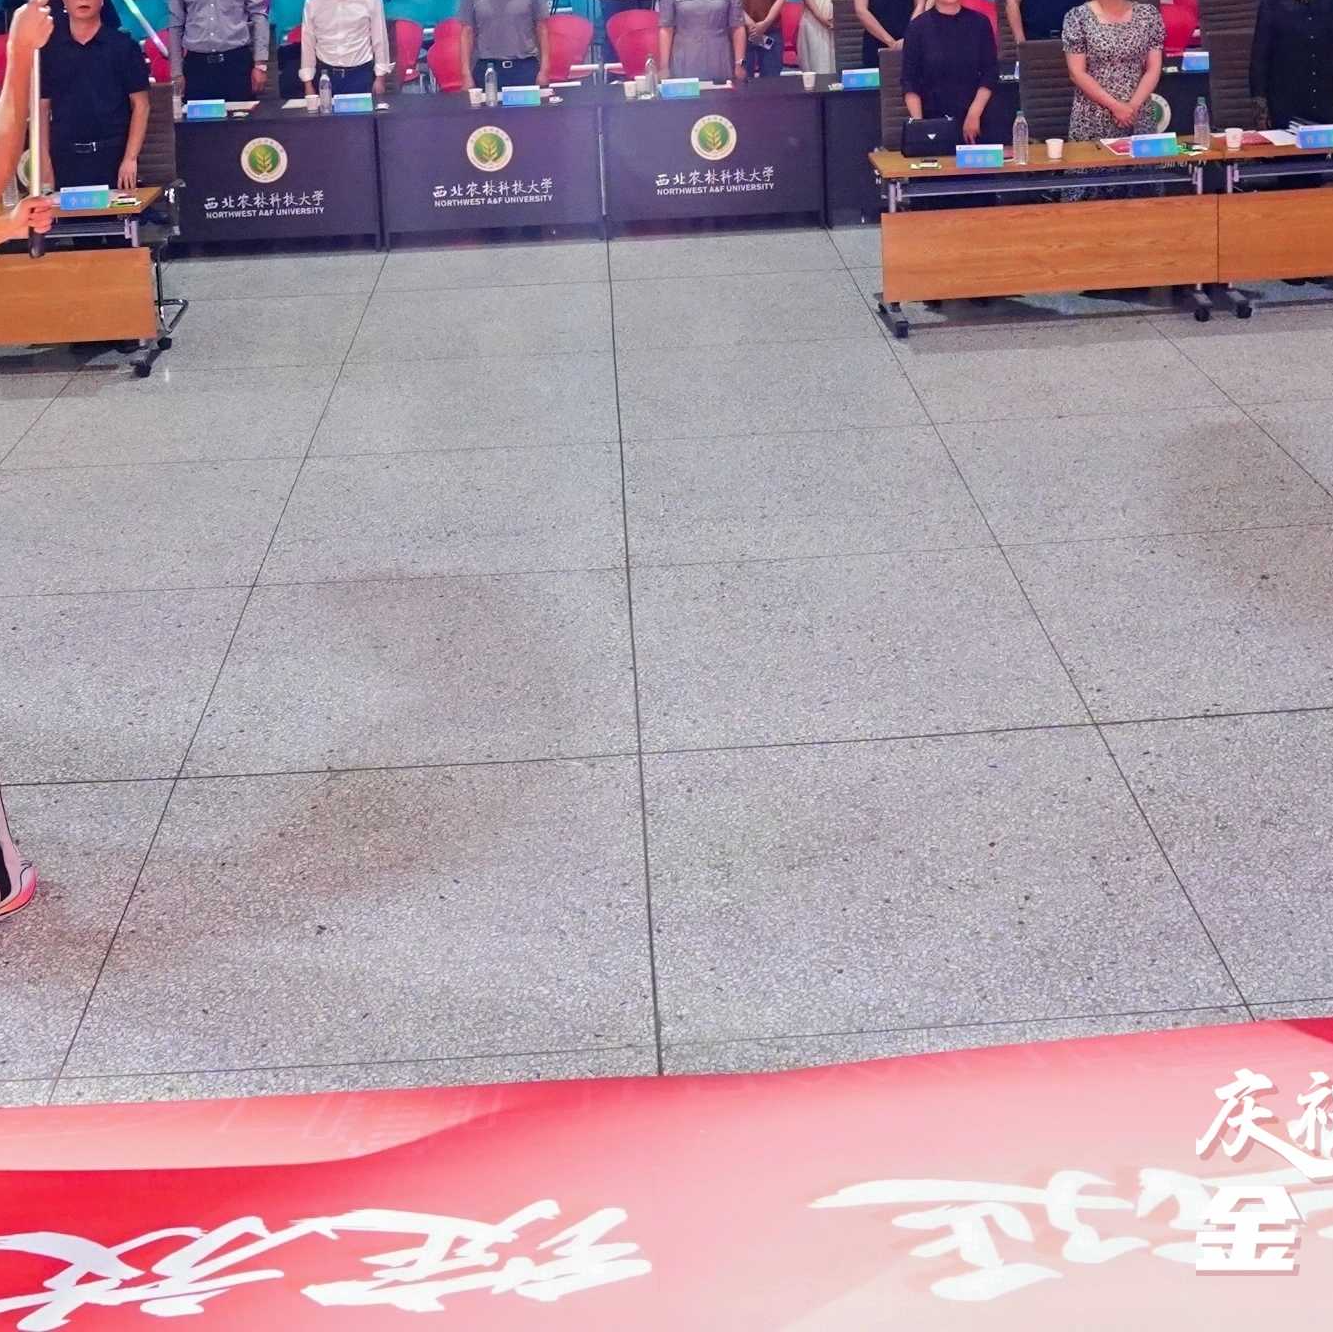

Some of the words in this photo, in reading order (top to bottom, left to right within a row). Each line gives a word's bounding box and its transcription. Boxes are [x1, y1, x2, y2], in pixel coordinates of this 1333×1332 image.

[656, 166, 775, 187] 西北农林科技大学
[432, 178, 553, 198] 西北农林科技大学
[657, 185, 708, 196] NORTHWEST
[709, 184, 725, 194] A&F
[726, 182, 775, 193] UNIVERSITY
[204, 190, 324, 211] 西北农林科技大学
[434, 197, 486, 208] NORTHWEST
[487, 196, 503, 206] A&F
[504, 194, 553, 205] UNIVERSITY
[206, 208, 258, 220] NORTHWEST
[258, 208, 274, 218] A&F
[275, 206, 324, 217] UNIVERSITY
